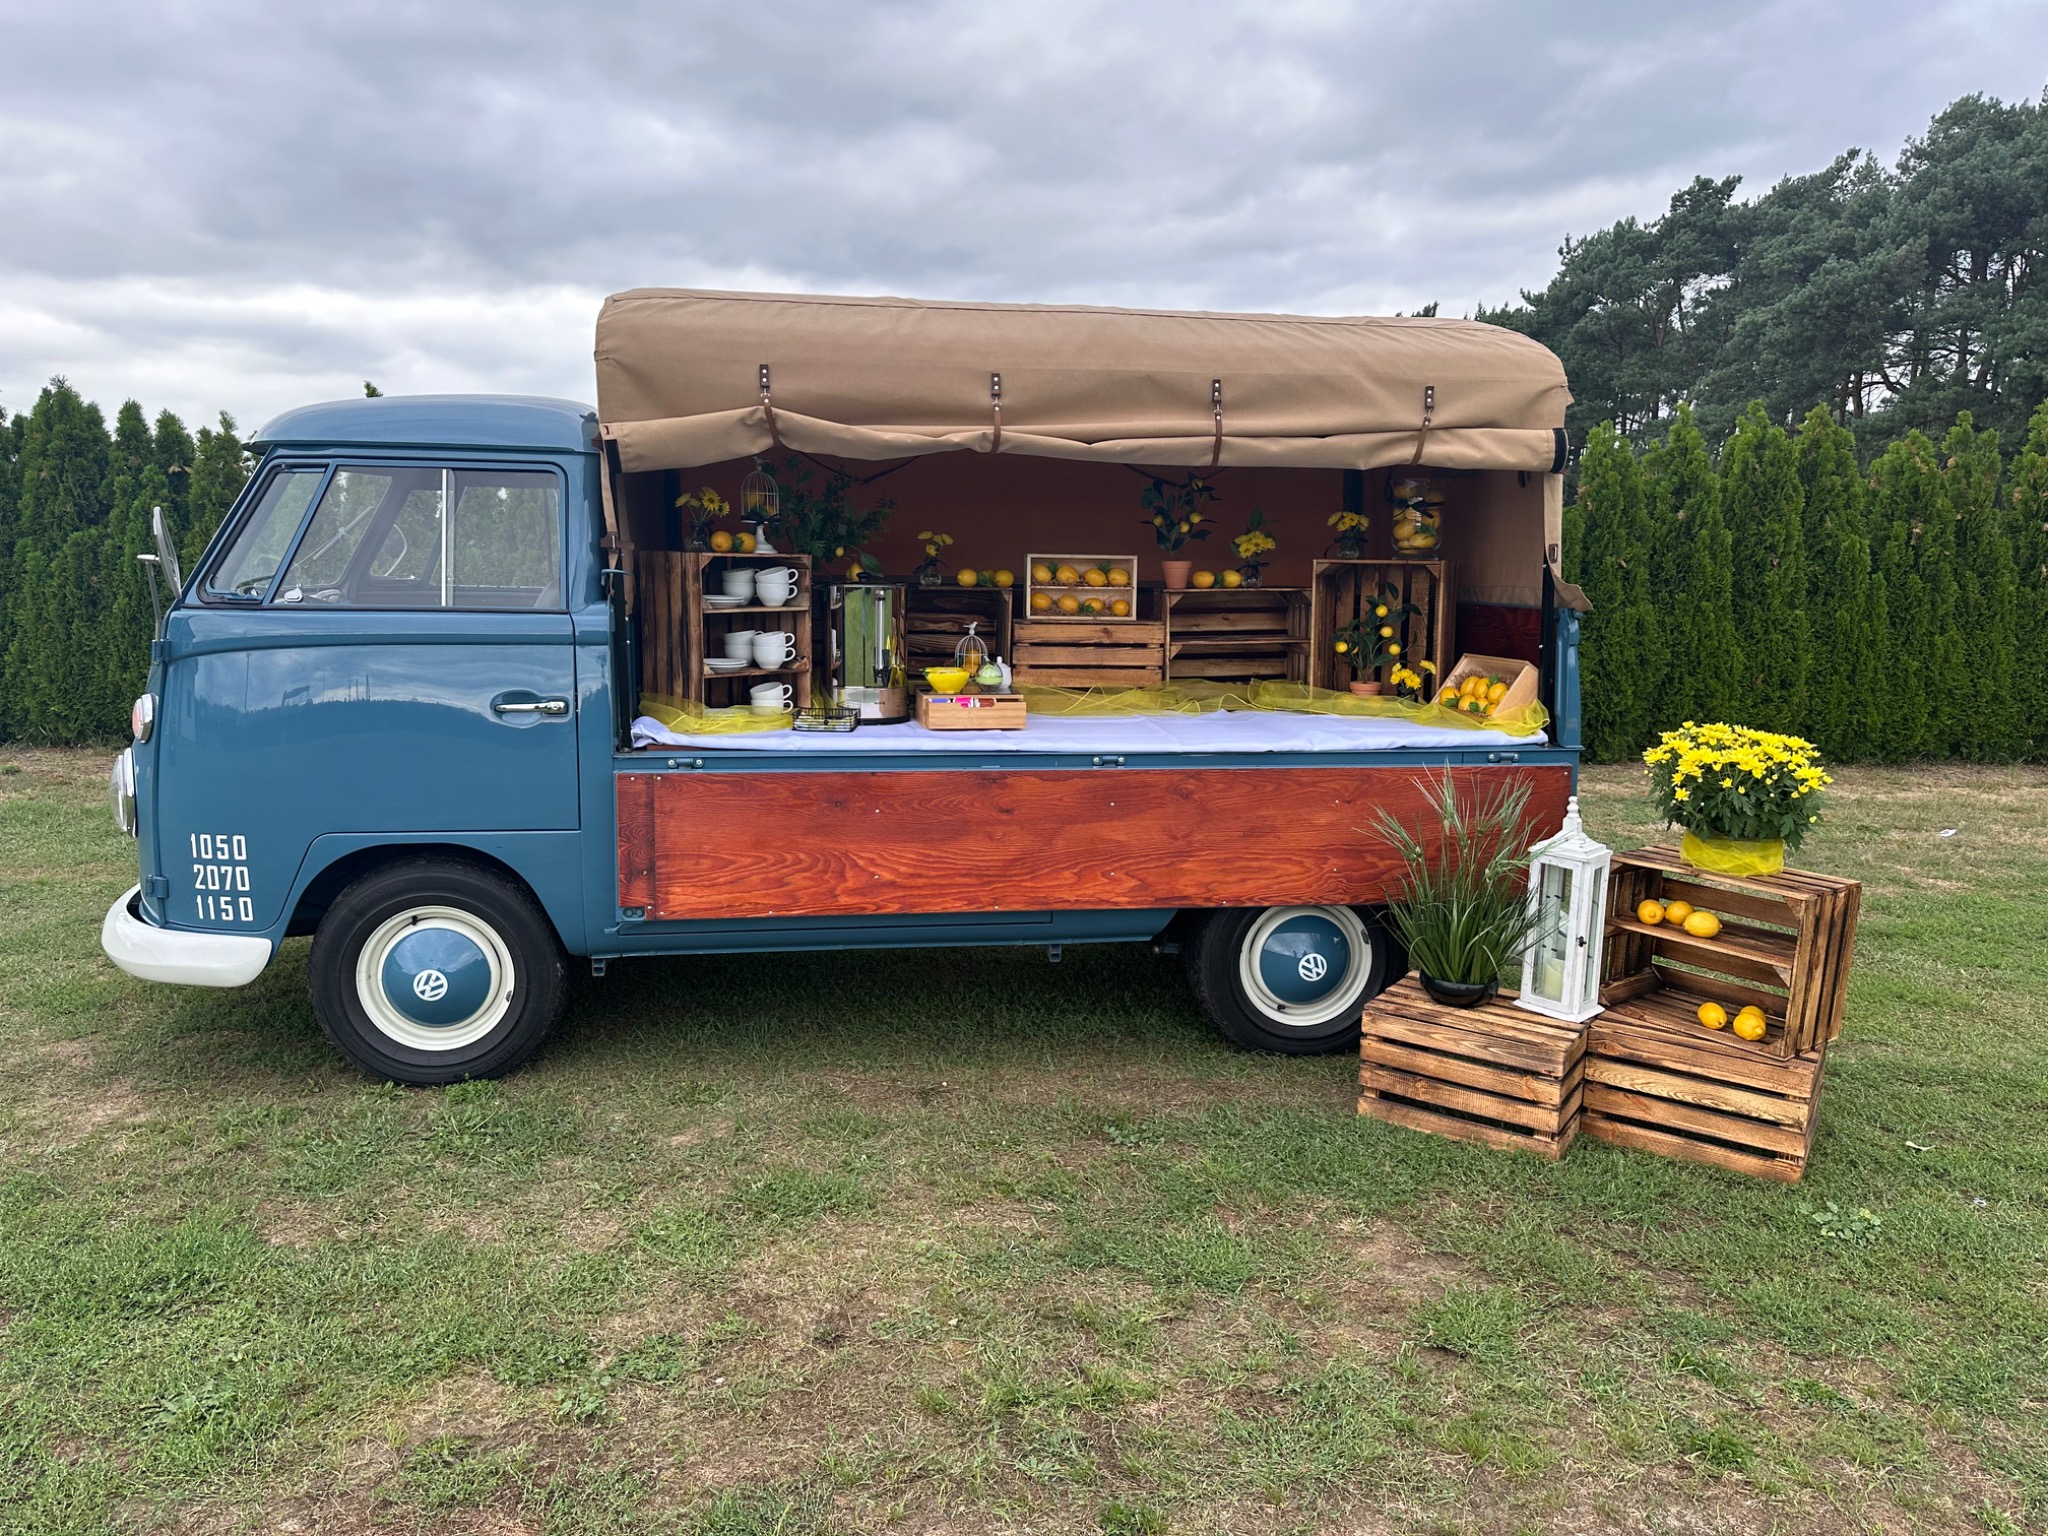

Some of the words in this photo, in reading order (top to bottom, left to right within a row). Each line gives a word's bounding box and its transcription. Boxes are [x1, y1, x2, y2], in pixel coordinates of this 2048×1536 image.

[190, 833, 247, 860] 1050
[193, 864, 250, 891] 2070
[196, 895, 254, 922] 1150
